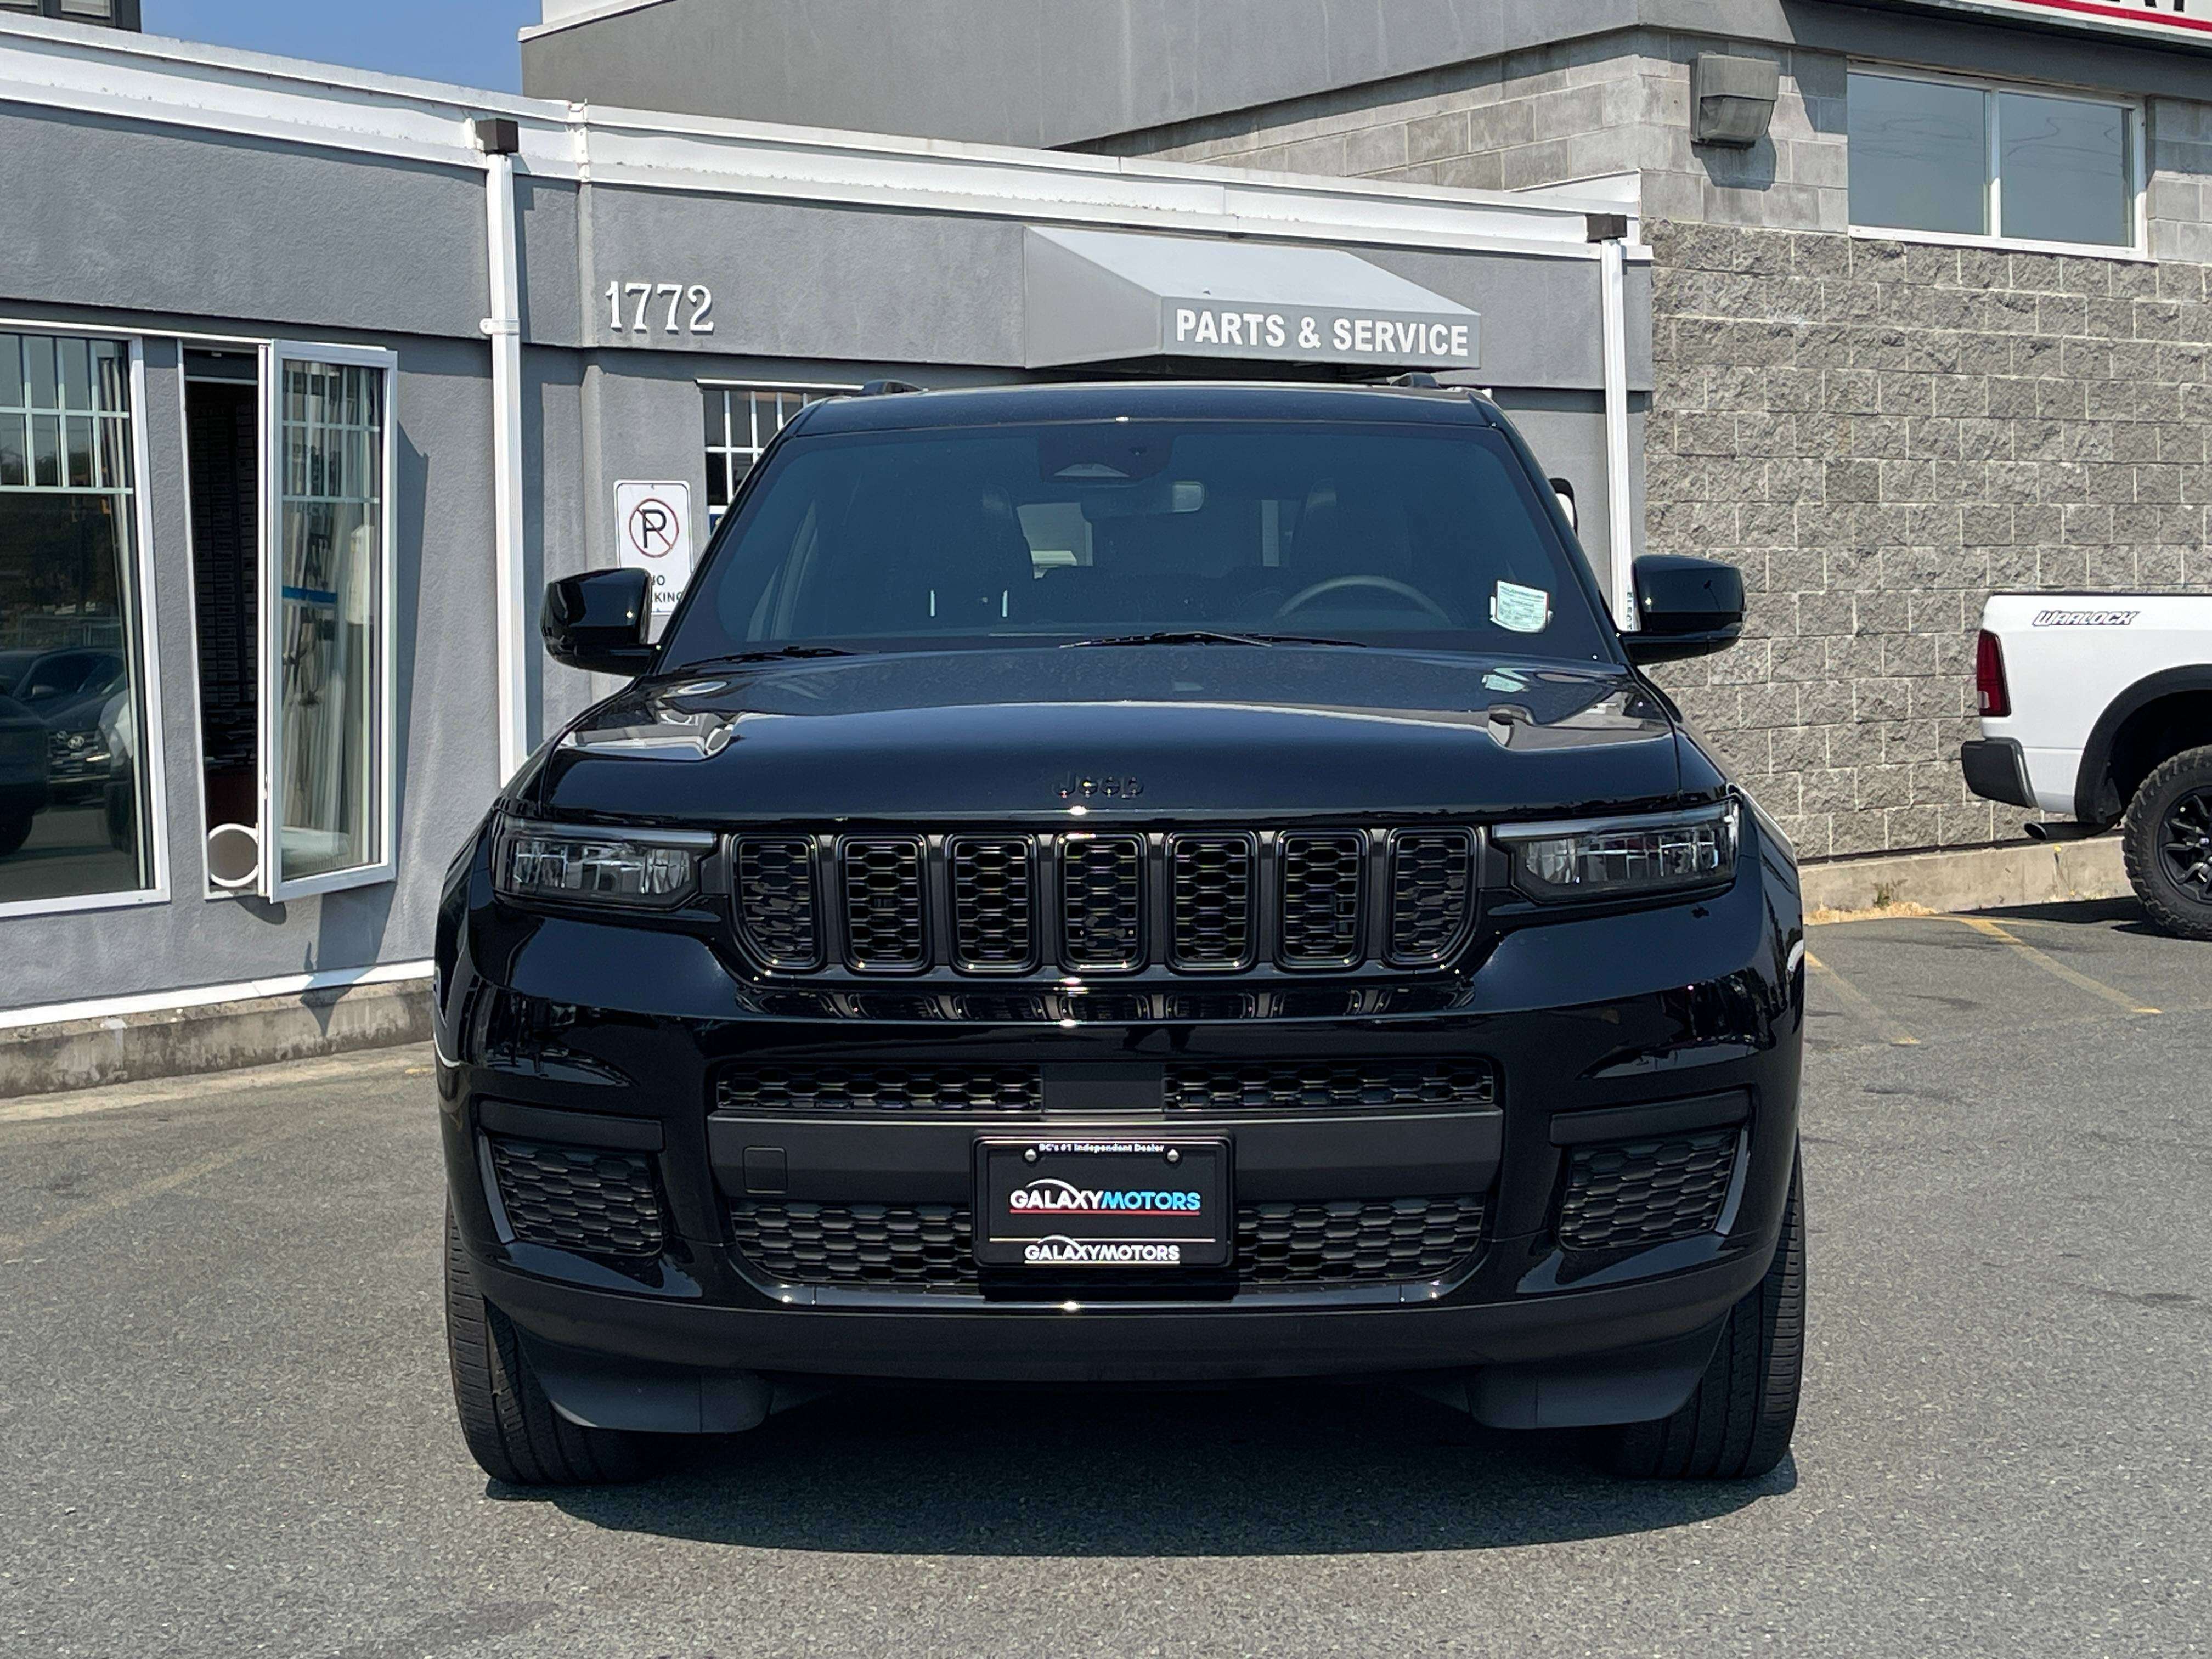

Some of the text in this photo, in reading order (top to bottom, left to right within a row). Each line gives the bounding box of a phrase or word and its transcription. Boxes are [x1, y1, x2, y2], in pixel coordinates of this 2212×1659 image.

[605, 281, 714, 331] 1772
[1176, 308, 1468, 356] PARTS & SERVICE
[654, 591, 683, 603] KING
[2032, 610, 2141, 627] WARLOCK
[1074, 1142, 1133, 1154] Independent
